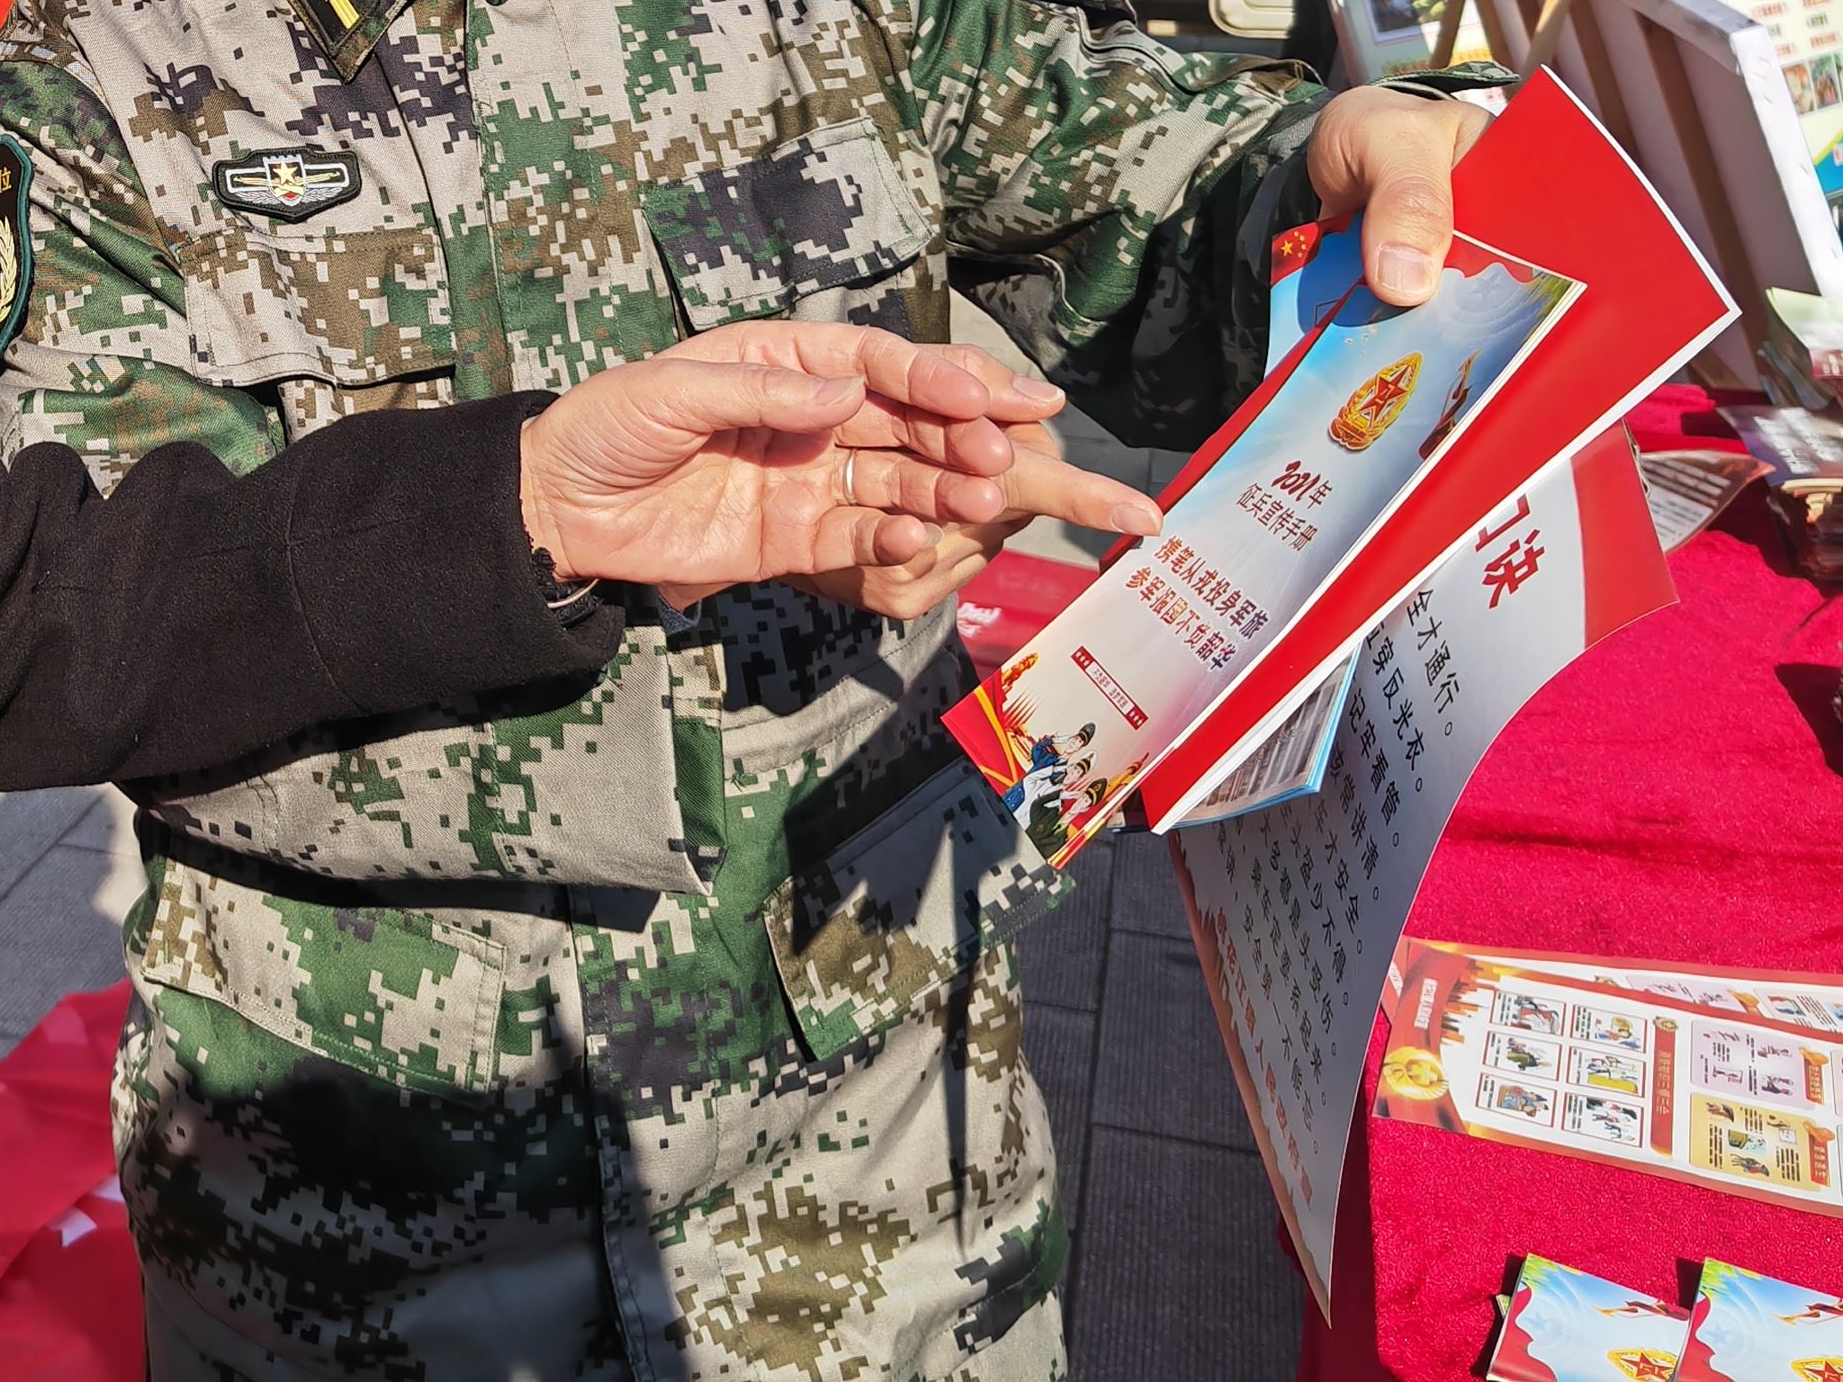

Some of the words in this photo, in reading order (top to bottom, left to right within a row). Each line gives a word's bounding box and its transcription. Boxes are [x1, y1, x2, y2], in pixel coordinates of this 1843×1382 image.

[1235, 481, 1319, 552] 征兵宣传手册
[1270, 458, 1334, 509] 2021年
[1124, 564, 1239, 673] 参军报国不负韶华
[1152, 533, 1270, 637] 携笔从戎投身军旅
